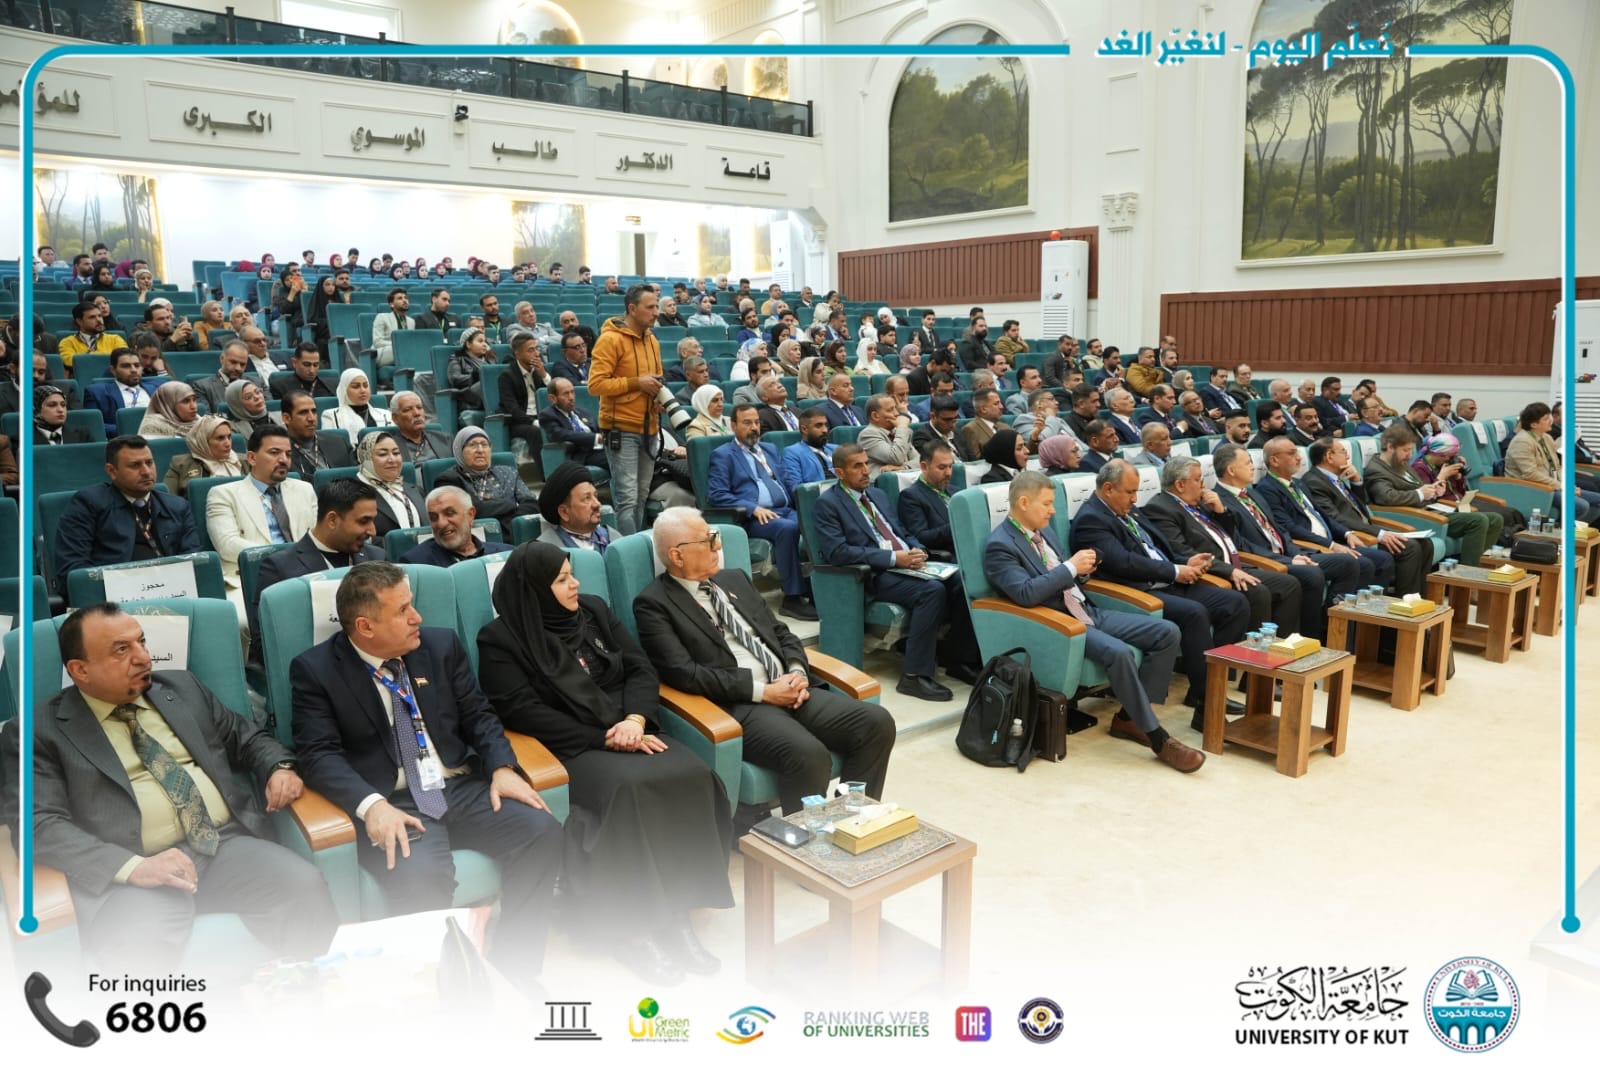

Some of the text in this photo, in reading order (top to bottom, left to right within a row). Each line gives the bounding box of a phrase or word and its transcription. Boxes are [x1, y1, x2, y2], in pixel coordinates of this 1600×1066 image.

[350, 126, 425, 153] الموسوي
[492, 139, 558, 161] طالب
[615, 152, 673, 171] الدكتور
[721, 157, 771, 180] قاعة
